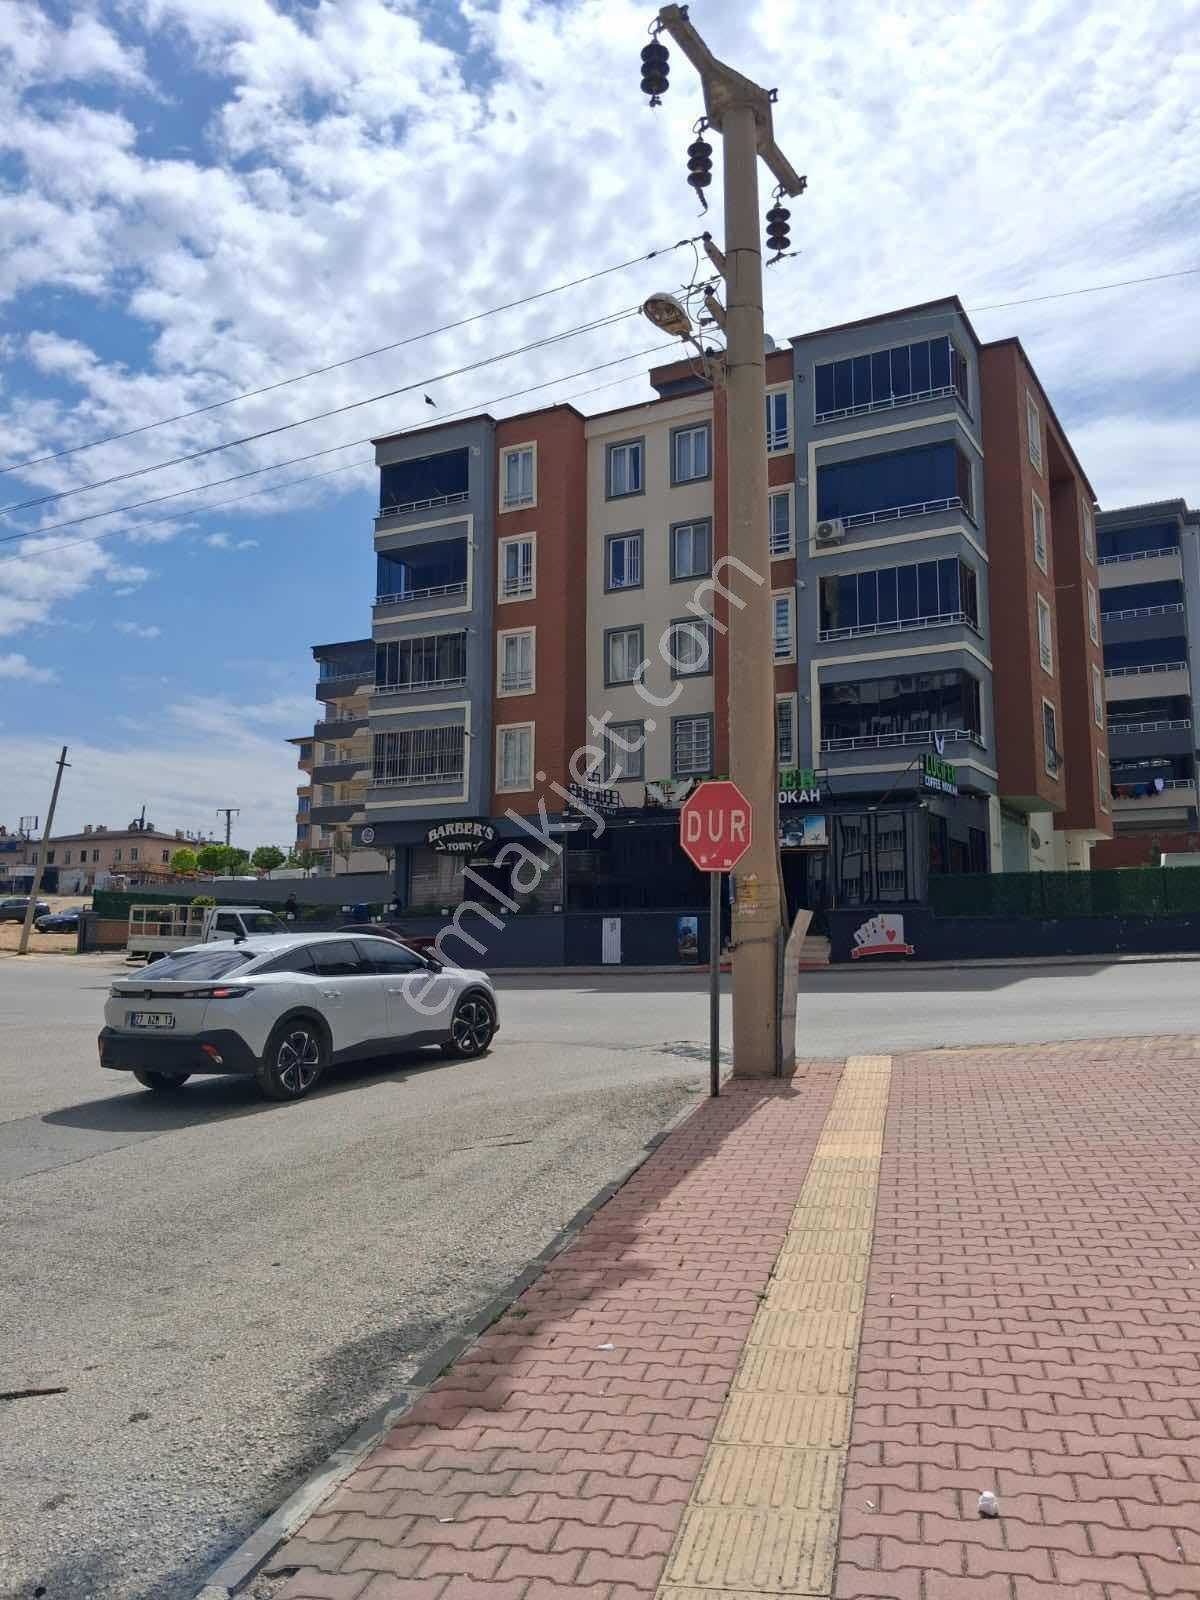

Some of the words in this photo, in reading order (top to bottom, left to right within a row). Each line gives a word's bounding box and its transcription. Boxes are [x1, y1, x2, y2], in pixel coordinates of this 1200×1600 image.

[778, 789, 820, 803] OKAH
[428, 822, 495, 842] BARBER'S
[687, 809, 745, 842] DUR
[447, 842, 472, 851] TOWN
